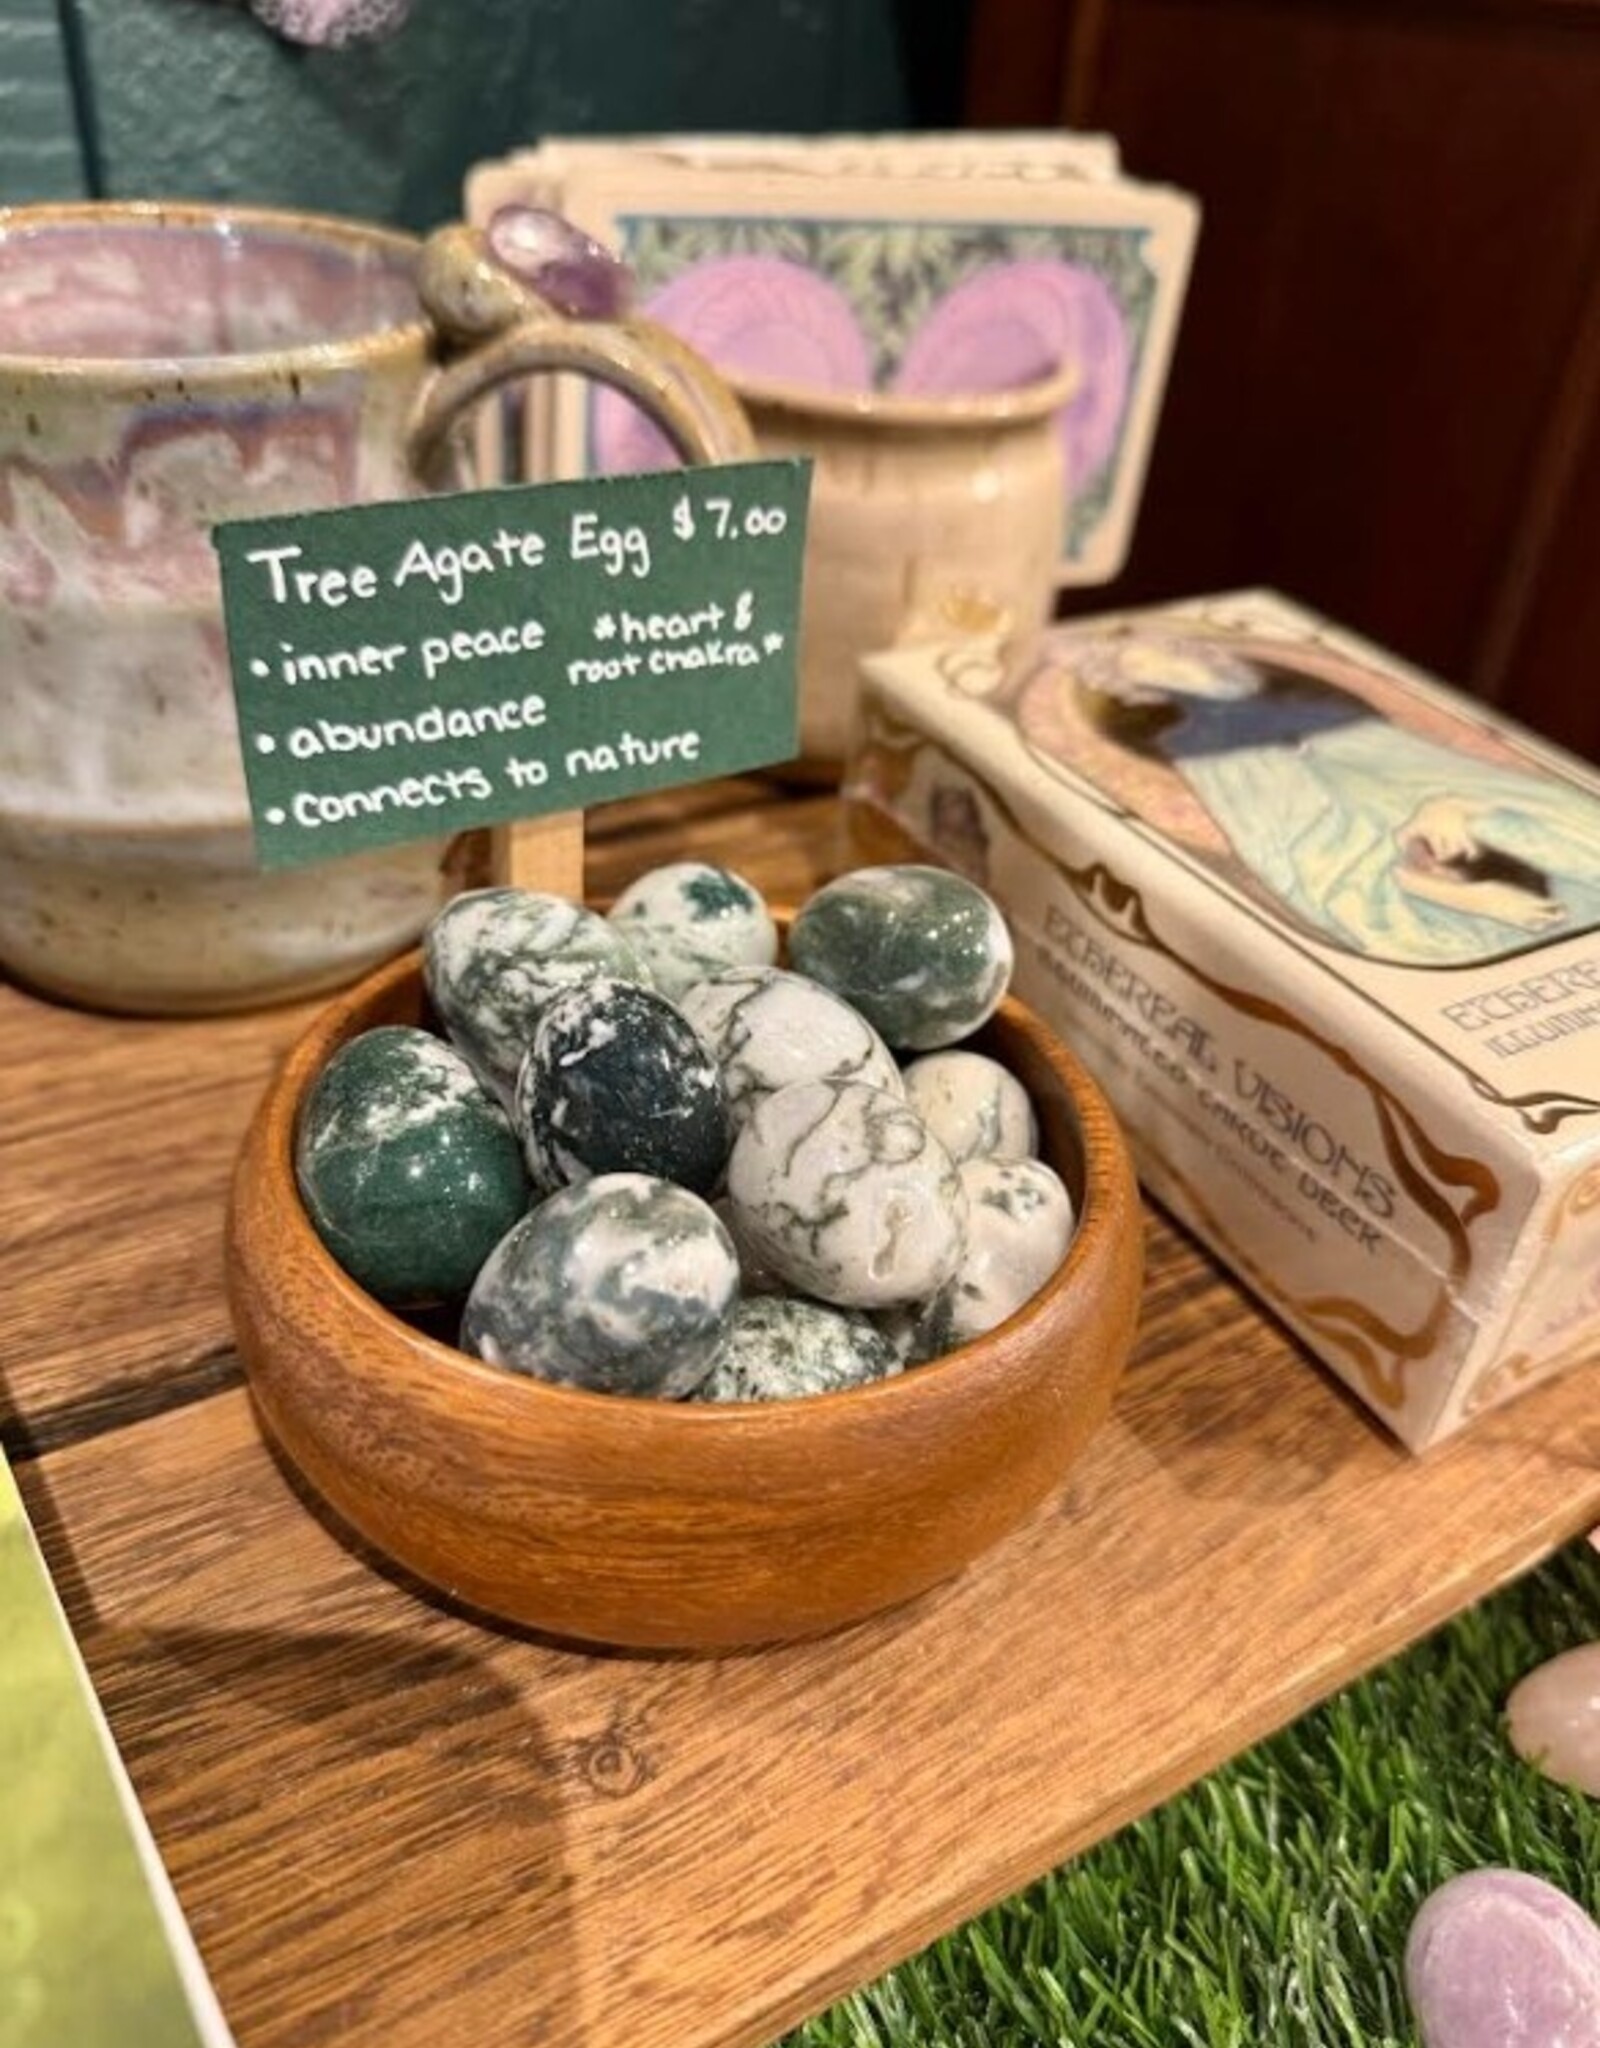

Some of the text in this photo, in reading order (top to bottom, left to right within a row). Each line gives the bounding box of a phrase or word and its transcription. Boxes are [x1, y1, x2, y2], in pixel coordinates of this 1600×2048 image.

[247, 545, 379, 607] Tree
[394, 529, 546, 605] Agate
[570, 512, 651, 578] Egg
[280, 620, 545, 685] inner peace
[567, 653, 642, 686] root
[288, 694, 546, 759] abundance
[505, 757, 549, 788] to
[565, 731, 700, 777] nature
[1234, 1057, 1396, 1220] VISIONS
[1298, 1171, 1382, 1254] DECK
